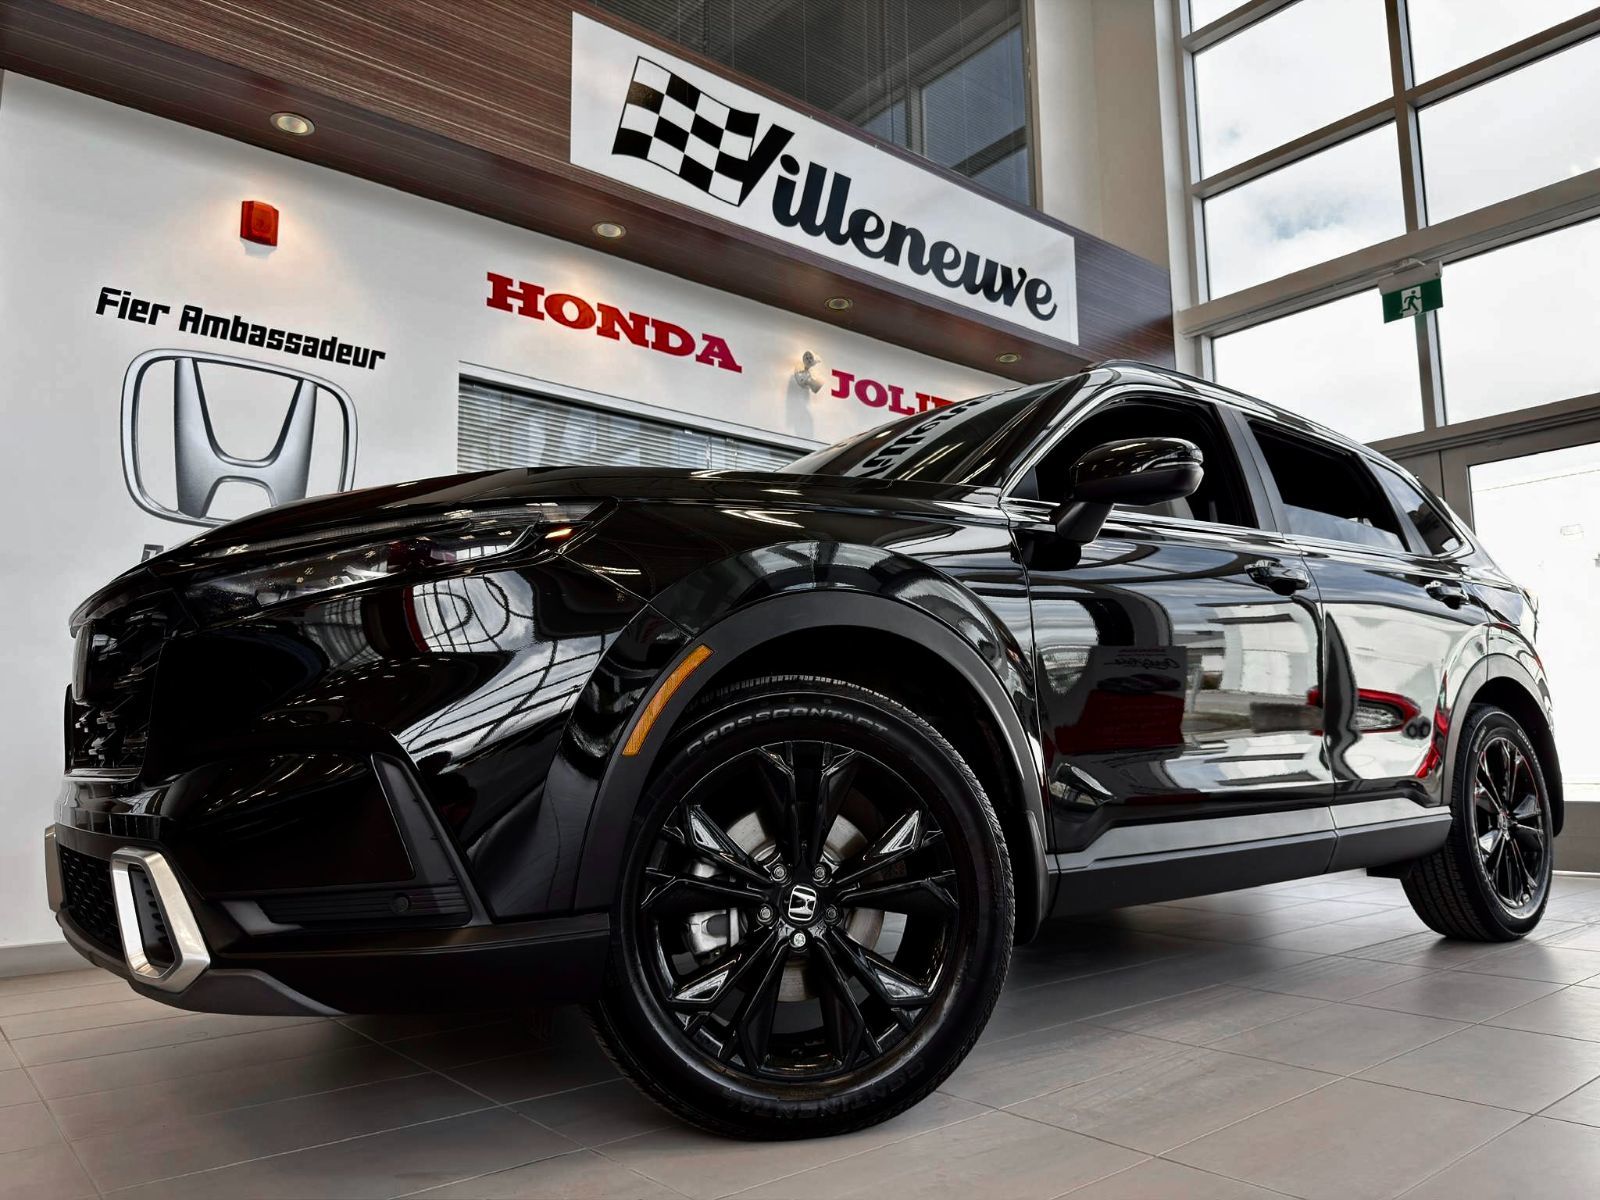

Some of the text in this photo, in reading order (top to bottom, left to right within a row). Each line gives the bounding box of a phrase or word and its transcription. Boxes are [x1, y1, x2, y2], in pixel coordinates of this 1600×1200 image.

[736, 112, 1058, 322] Villeneuve
[96, 286, 386, 370] Fier Ambassadeur
[487, 272, 742, 373] HONDA
